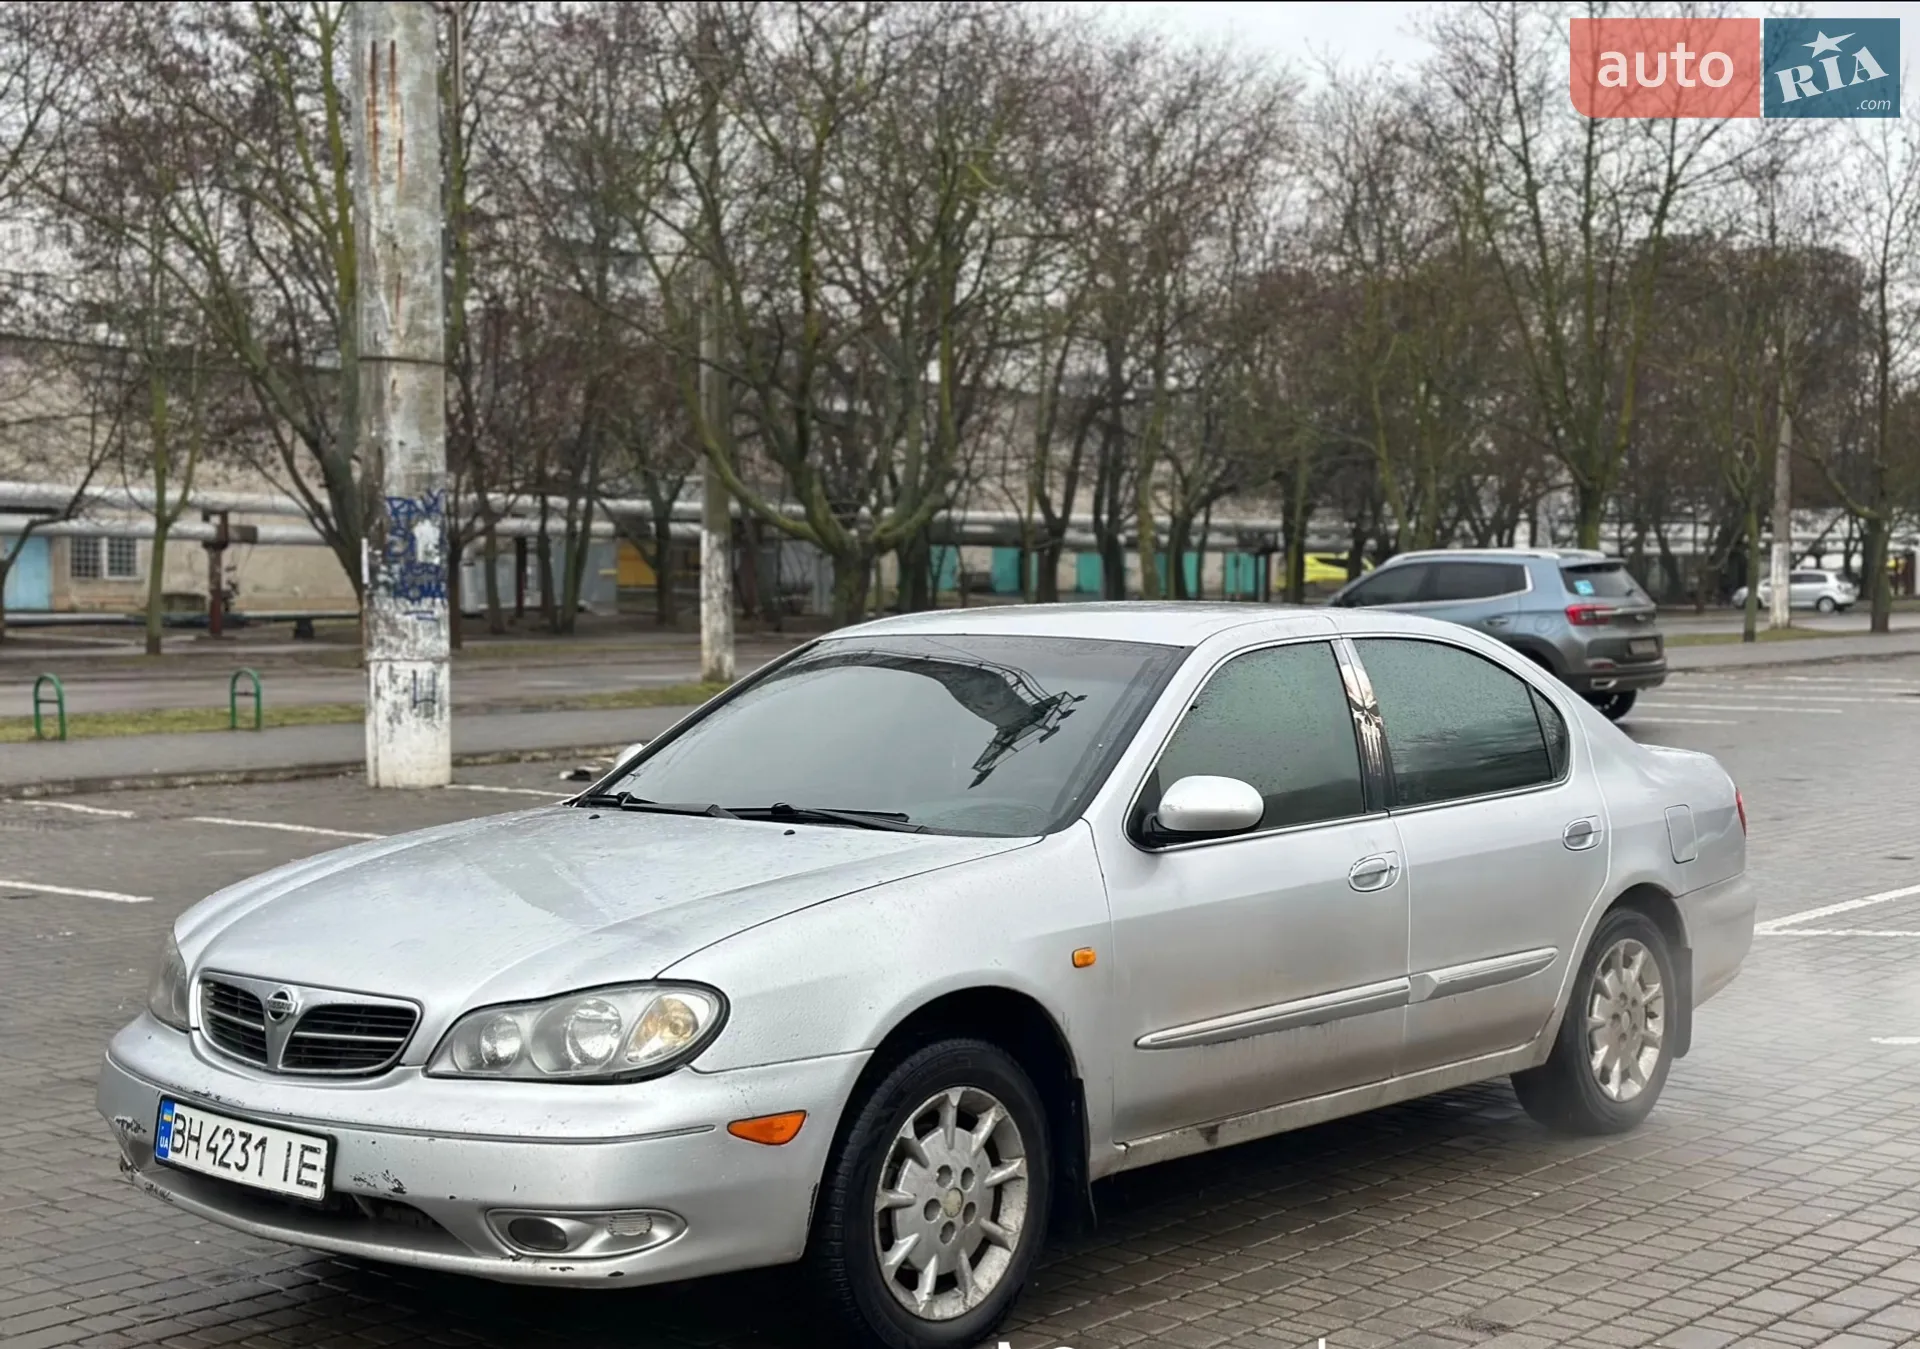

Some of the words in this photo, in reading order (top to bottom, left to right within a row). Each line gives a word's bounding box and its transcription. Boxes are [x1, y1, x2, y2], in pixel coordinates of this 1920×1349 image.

[159, 1135, 169, 1149] UA
[171, 1112, 204, 1161] BH
[205, 1124, 268, 1178] 4231
[282, 1140, 322, 1190] IE
